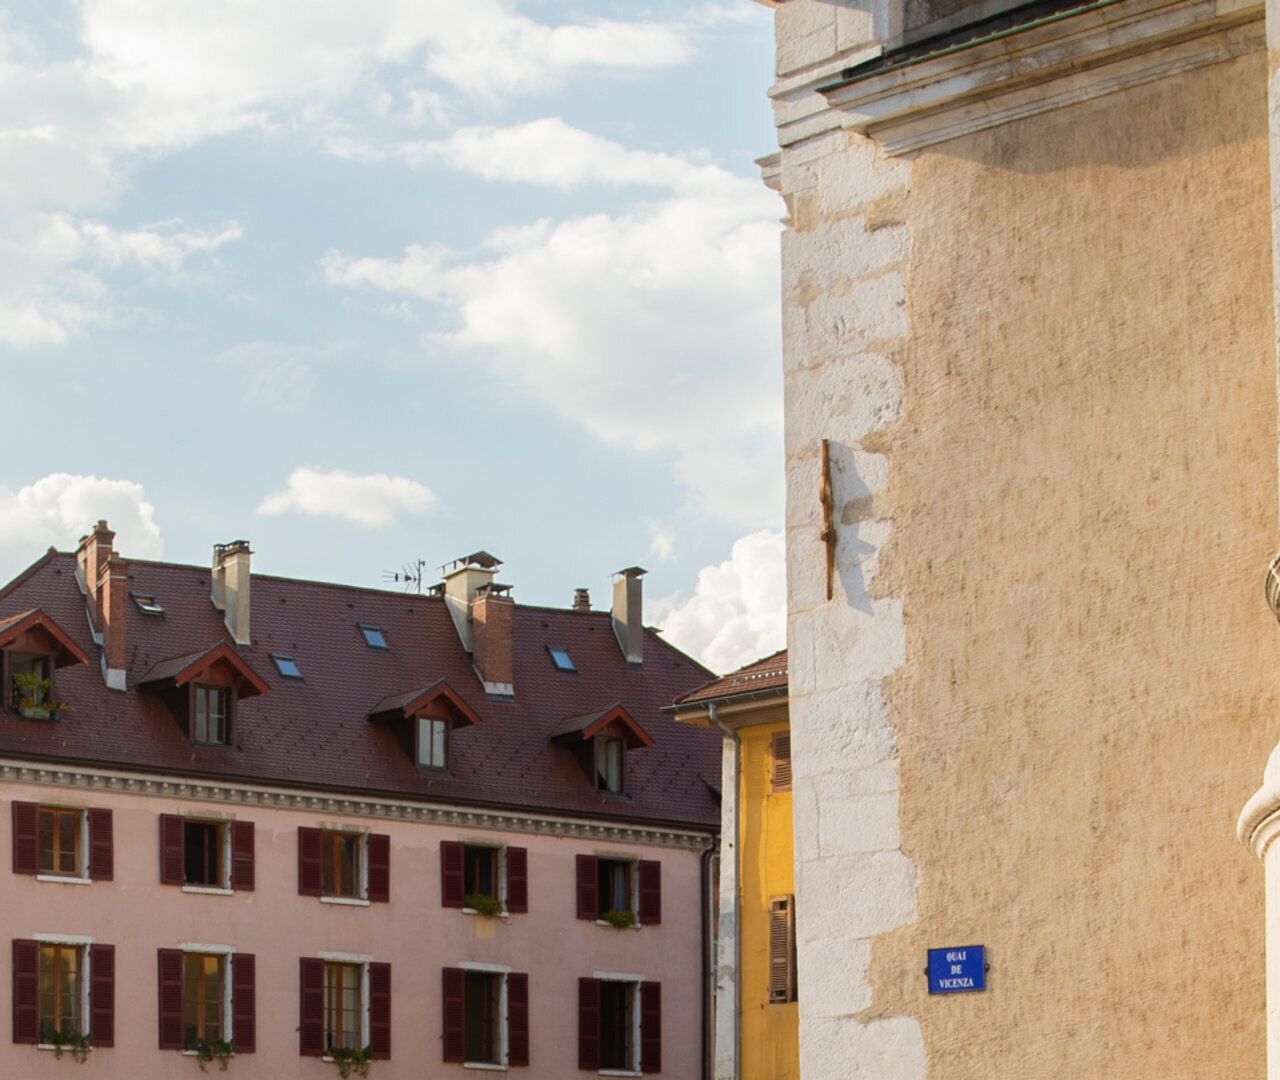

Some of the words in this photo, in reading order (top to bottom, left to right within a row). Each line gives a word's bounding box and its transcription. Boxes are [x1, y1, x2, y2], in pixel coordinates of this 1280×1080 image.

[946, 951, 966, 962] QUAI
[951, 964, 962, 975] DE
[939, 977, 974, 988] VICENZA
